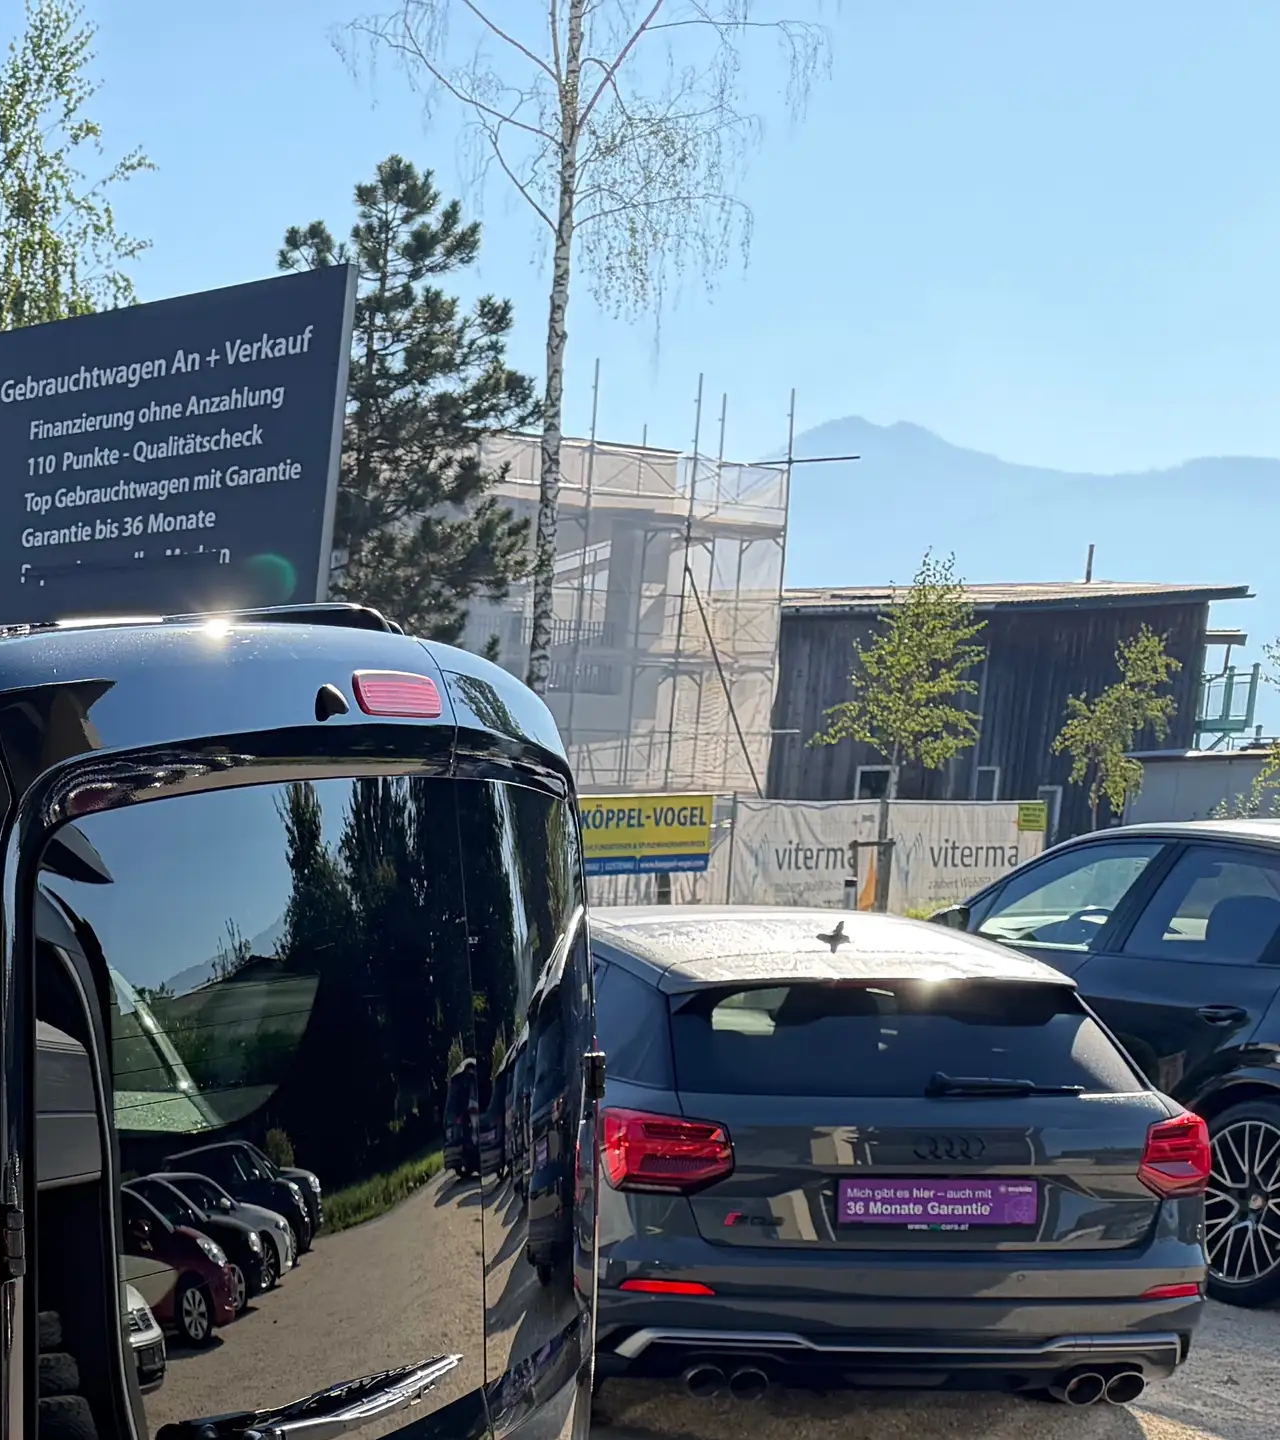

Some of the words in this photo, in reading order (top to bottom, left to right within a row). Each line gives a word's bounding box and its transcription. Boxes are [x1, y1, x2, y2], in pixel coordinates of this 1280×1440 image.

[0, 357, 167, 403] Gebrauchtwagen
[171, 349, 200, 374] An
[205, 349, 220, 368] +
[225, 325, 314, 365] Verkauf
[29, 408, 135, 440] Finanzierung
[138, 400, 182, 424] ohne
[186, 385, 285, 417] Anzahlung
[27, 456, 56, 476] 110
[62, 446, 120, 472] Punkte
[133, 424, 263, 463] Qualitätscheck
[24, 491, 52, 515] Top
[55, 476, 190, 509] Gebrauchtwagen
[193, 469, 222, 491] mit
[225, 459, 302, 487] Garantie
[21, 520, 91, 548] Garantie
[95, 518, 119, 540] bis
[122, 516, 144, 537] 36
[147, 510, 216, 534] Monate
[580, 803, 707, 830] KÖPPEL-VOGEL
[929, 838, 1019, 868] viterma
[846, 1201, 864, 1215] 36
[868, 1201, 923, 1215] Monate
[847, 1188, 872, 1198] Mich
[874, 1188, 895, 1200] gibt
[896, 1189, 910, 1198] es
[912, 1187, 935, 1198] hier
[946, 1188, 974, 1198] auch
[975, 1187, 992, 1199] mit
